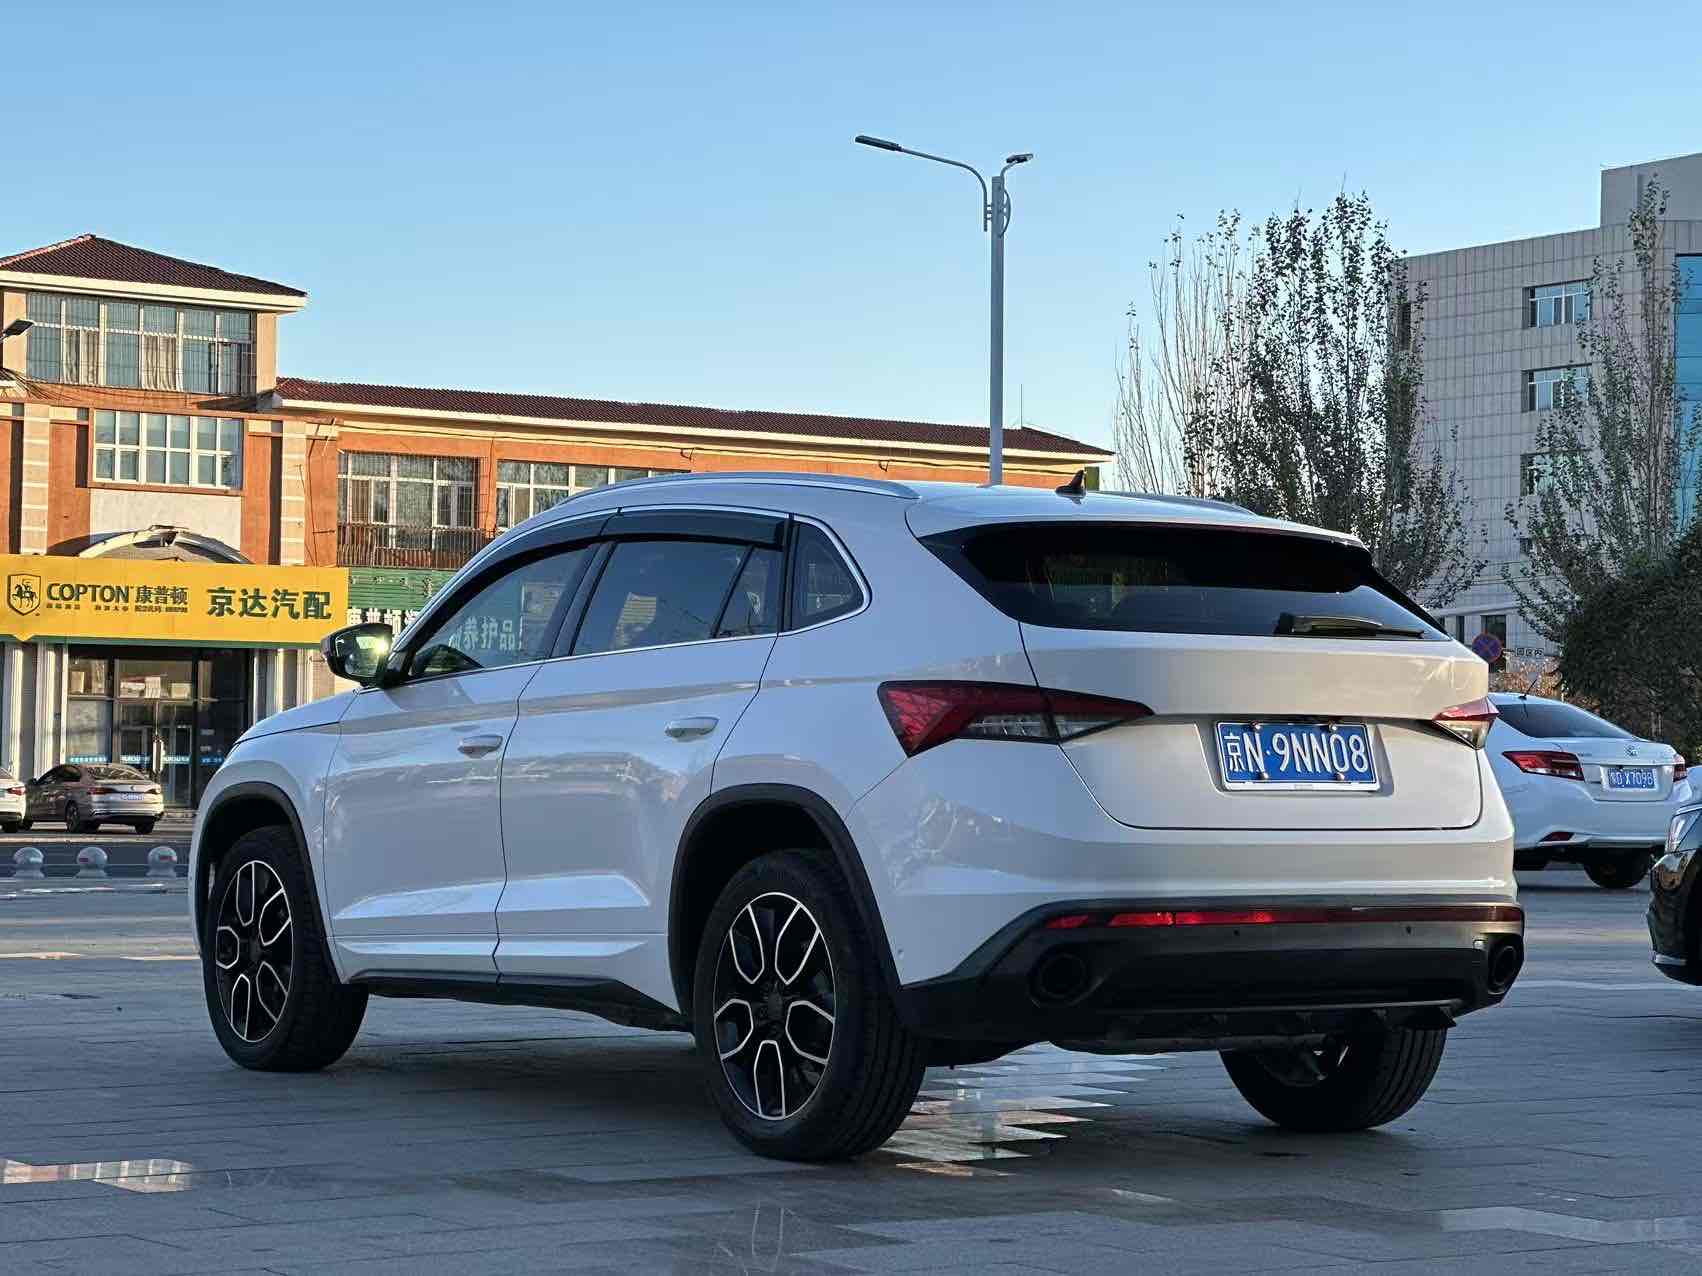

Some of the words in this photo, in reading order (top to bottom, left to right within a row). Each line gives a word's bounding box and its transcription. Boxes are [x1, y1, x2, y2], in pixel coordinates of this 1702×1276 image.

[47, 583, 130, 603] COPTON
[134, 585, 189, 605] 康普顿
[206, 586, 332, 620] 京达汽配
